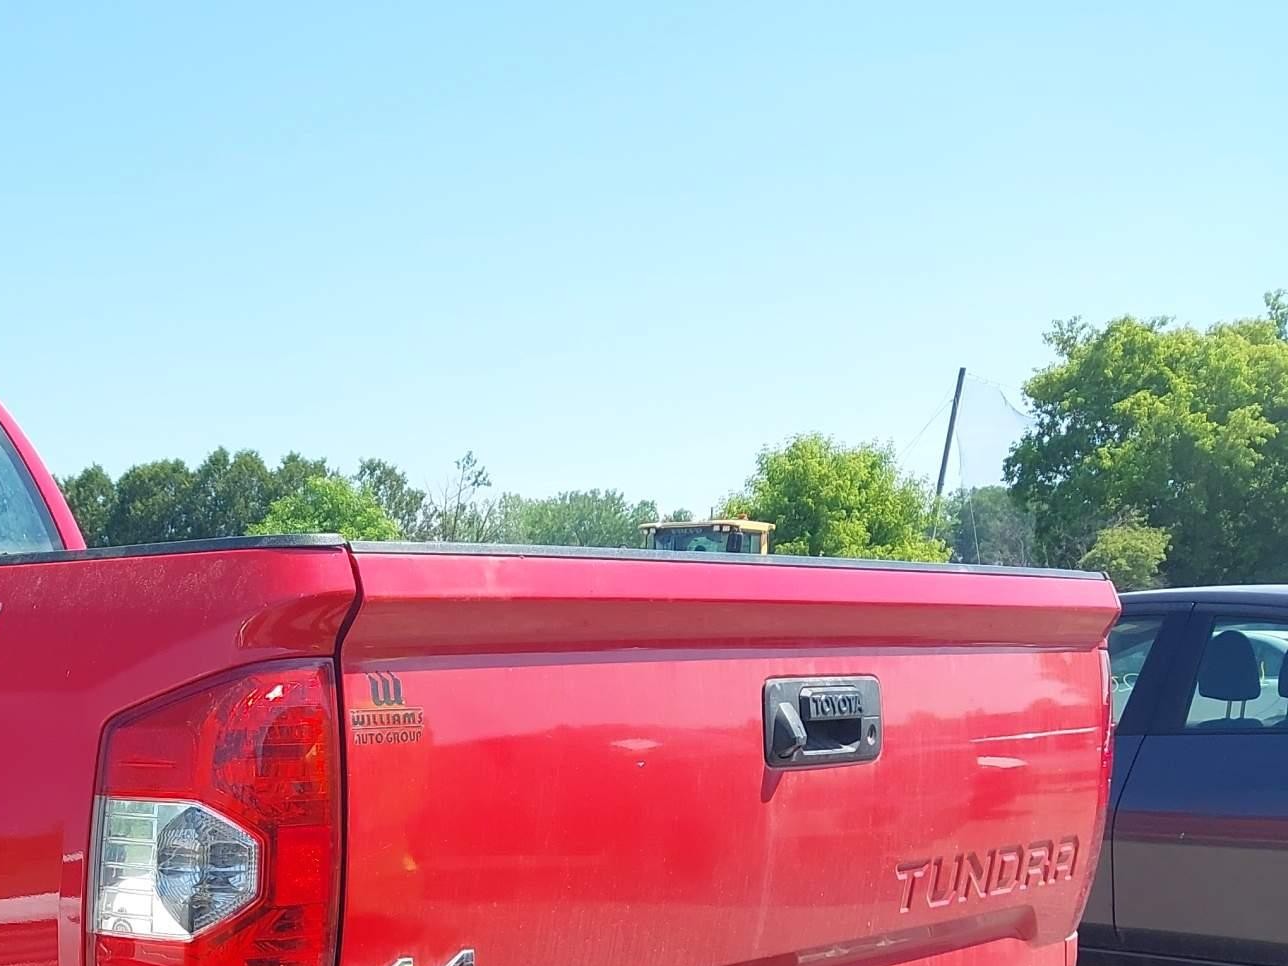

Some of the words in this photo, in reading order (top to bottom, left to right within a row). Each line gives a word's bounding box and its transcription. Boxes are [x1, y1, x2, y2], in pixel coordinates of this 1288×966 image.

[811, 694, 863, 716] TOYOTA
[351, 711, 423, 726] WILLIAMS
[354, 732, 384, 745] AUTO
[386, 731, 422, 744] GROUP
[895, 834, 1080, 914] TUNDRA
